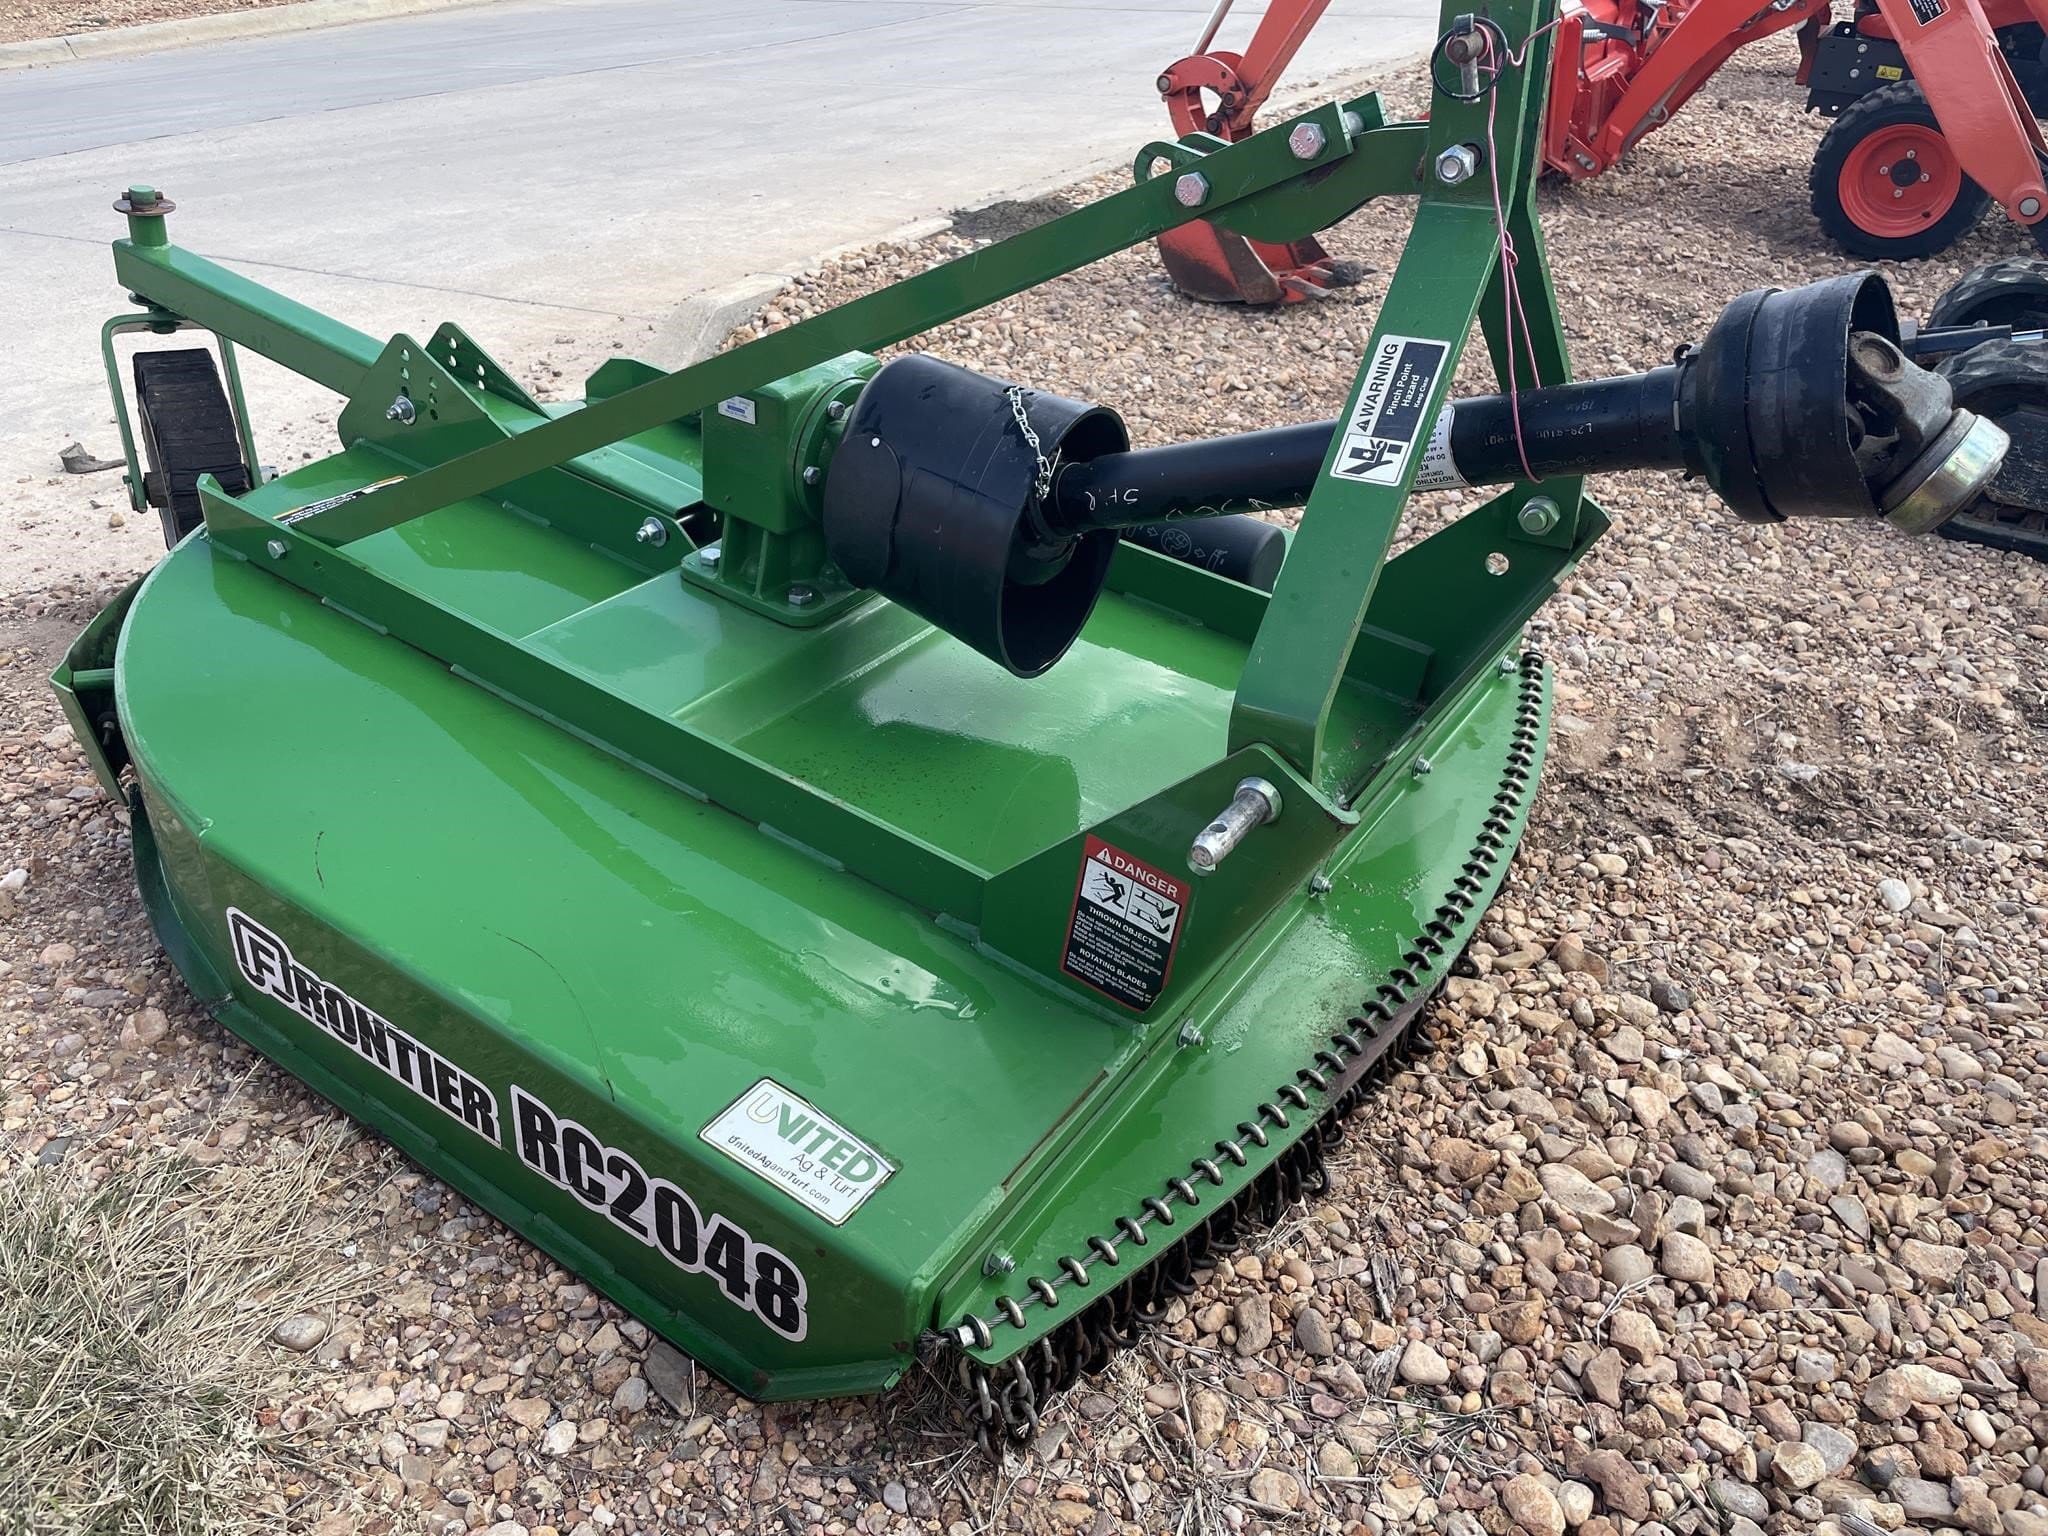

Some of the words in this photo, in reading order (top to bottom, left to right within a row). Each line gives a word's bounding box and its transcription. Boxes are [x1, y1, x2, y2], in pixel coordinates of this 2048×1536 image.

[1360, 344, 1399, 420] WARNING
[1386, 388, 1403, 416] Pinch
[1396, 363, 1413, 388] Point
[1401, 374, 1420, 407] Hazard
[1414, 393, 1424, 408] Keep
[1416, 476, 1454, 486] ROTATING
[1114, 856, 1178, 898] DANGER
[1087, 905, 1121, 928] THROWN
[1122, 924, 1158, 948] OBJECTS
[1079, 946, 1116, 972] ROTATING
[1116, 967, 1147, 989] BLADES
[227, 908, 501, 1149] FRONTIER
[512, 1087, 805, 1339] RC2048
[746, 1092, 878, 1182] UNITED
[727, 1135, 831, 1205] UnitedAgandTurf.com
[790, 1152, 814, 1172] Ag
[814, 1166, 829, 1180] &
[828, 1174, 860, 1198] Turf
